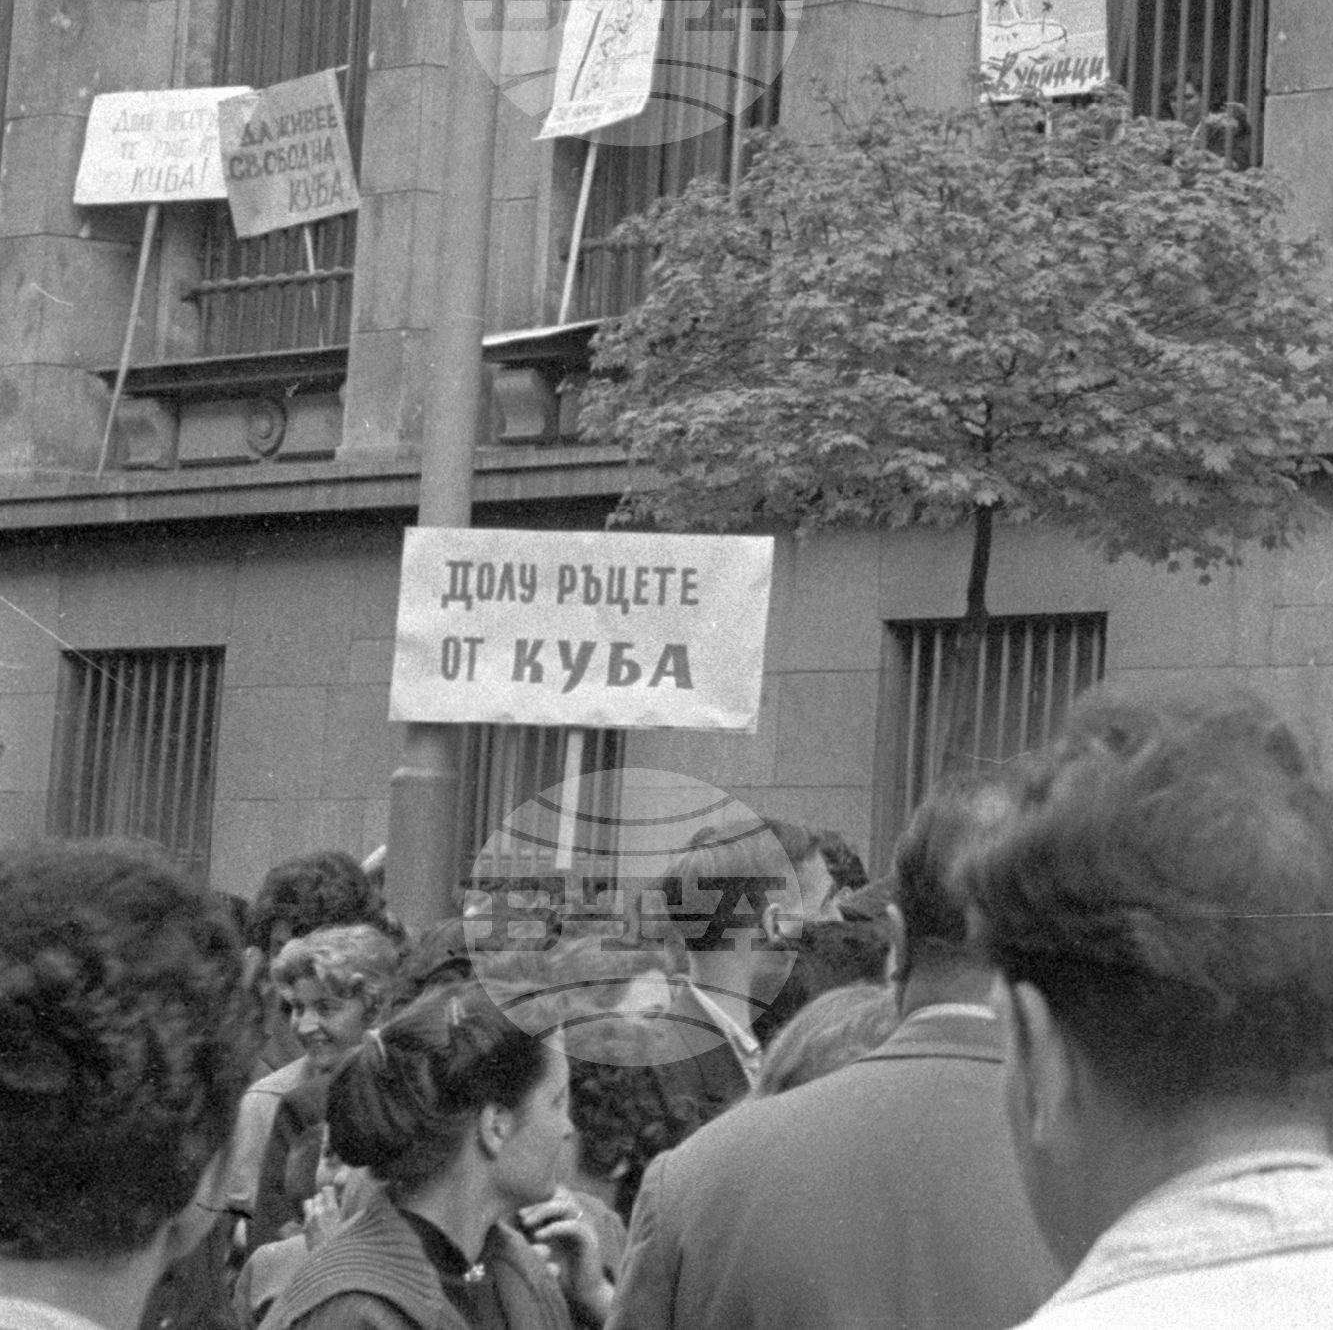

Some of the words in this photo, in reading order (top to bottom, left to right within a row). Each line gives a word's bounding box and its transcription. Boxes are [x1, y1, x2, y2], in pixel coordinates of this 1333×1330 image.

[240, 121, 271, 147] ДА
[277, 104, 338, 137] ЖИВЕЕ
[228, 137, 336, 181] СВОБОДНА
[441, 560, 538, 611] ДОЛУ
[557, 563, 700, 615] РЪЦЕТЕ
[441, 637, 485, 682] ОТ
[511, 638, 695, 695] КУБА
